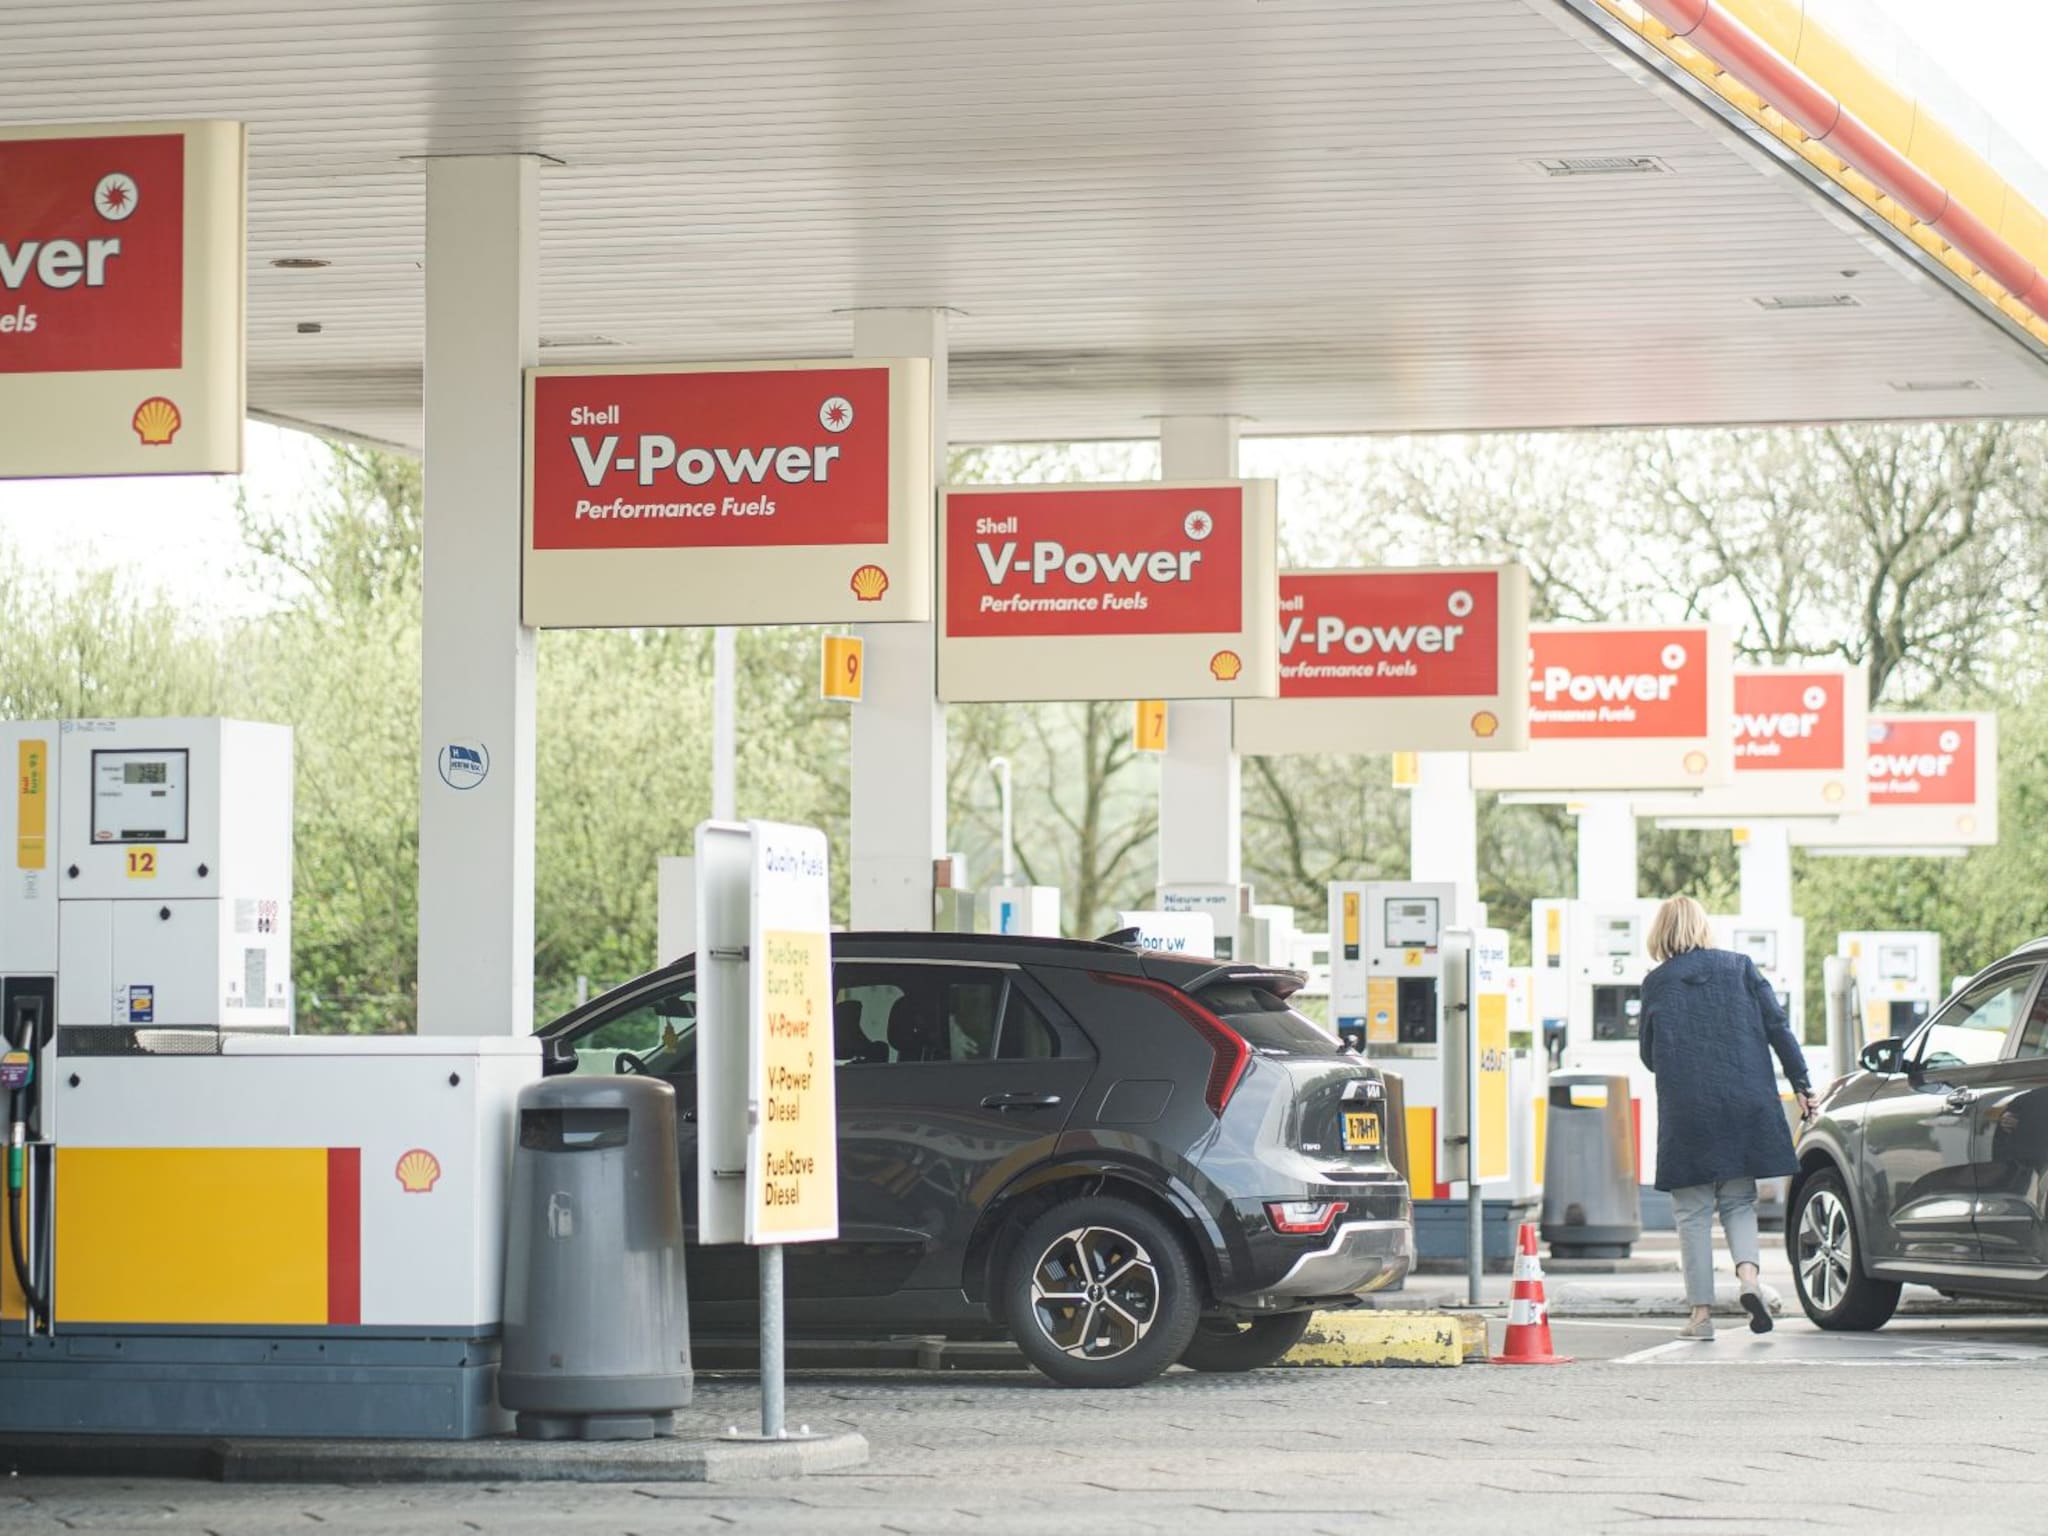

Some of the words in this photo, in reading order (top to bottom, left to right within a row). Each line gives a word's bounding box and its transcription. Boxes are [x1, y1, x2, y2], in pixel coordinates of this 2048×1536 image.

[570, 405, 620, 426] Shell
[569, 433, 840, 488] V-Power
[575, 497, 716, 520] Performance
[721, 494, 776, 516] Fuels
[976, 516, 1018, 535] Shell
[975, 540, 1202, 585] V-Power
[980, 593, 1098, 613] Performance
[1102, 591, 1148, 611] Fuels
[1279, 615, 1464, 655] V-Power
[847, 652, 859, 684] 9
[1279, 660, 1374, 679] erformance
[1377, 659, 1418, 678] Fuels
[1529, 666, 1679, 702] -Power
[1154, 713, 1163, 738] 7
[128, 852, 154, 874] 12
[767, 846, 799, 881] Quality
[802, 849, 824, 877] Fuels
[768, 939, 810, 966] FuelSave
[1612, 958, 1625, 976] 5
[768, 969, 789, 995] Euro
[793, 971, 804, 995] 95
[768, 1013, 810, 1038] V-Power
[768, 1066, 812, 1091] V-Power
[768, 1093, 800, 1122] Diesel
[766, 1150, 814, 1177] FuelSave
[765, 1178, 800, 1206] Diesel
